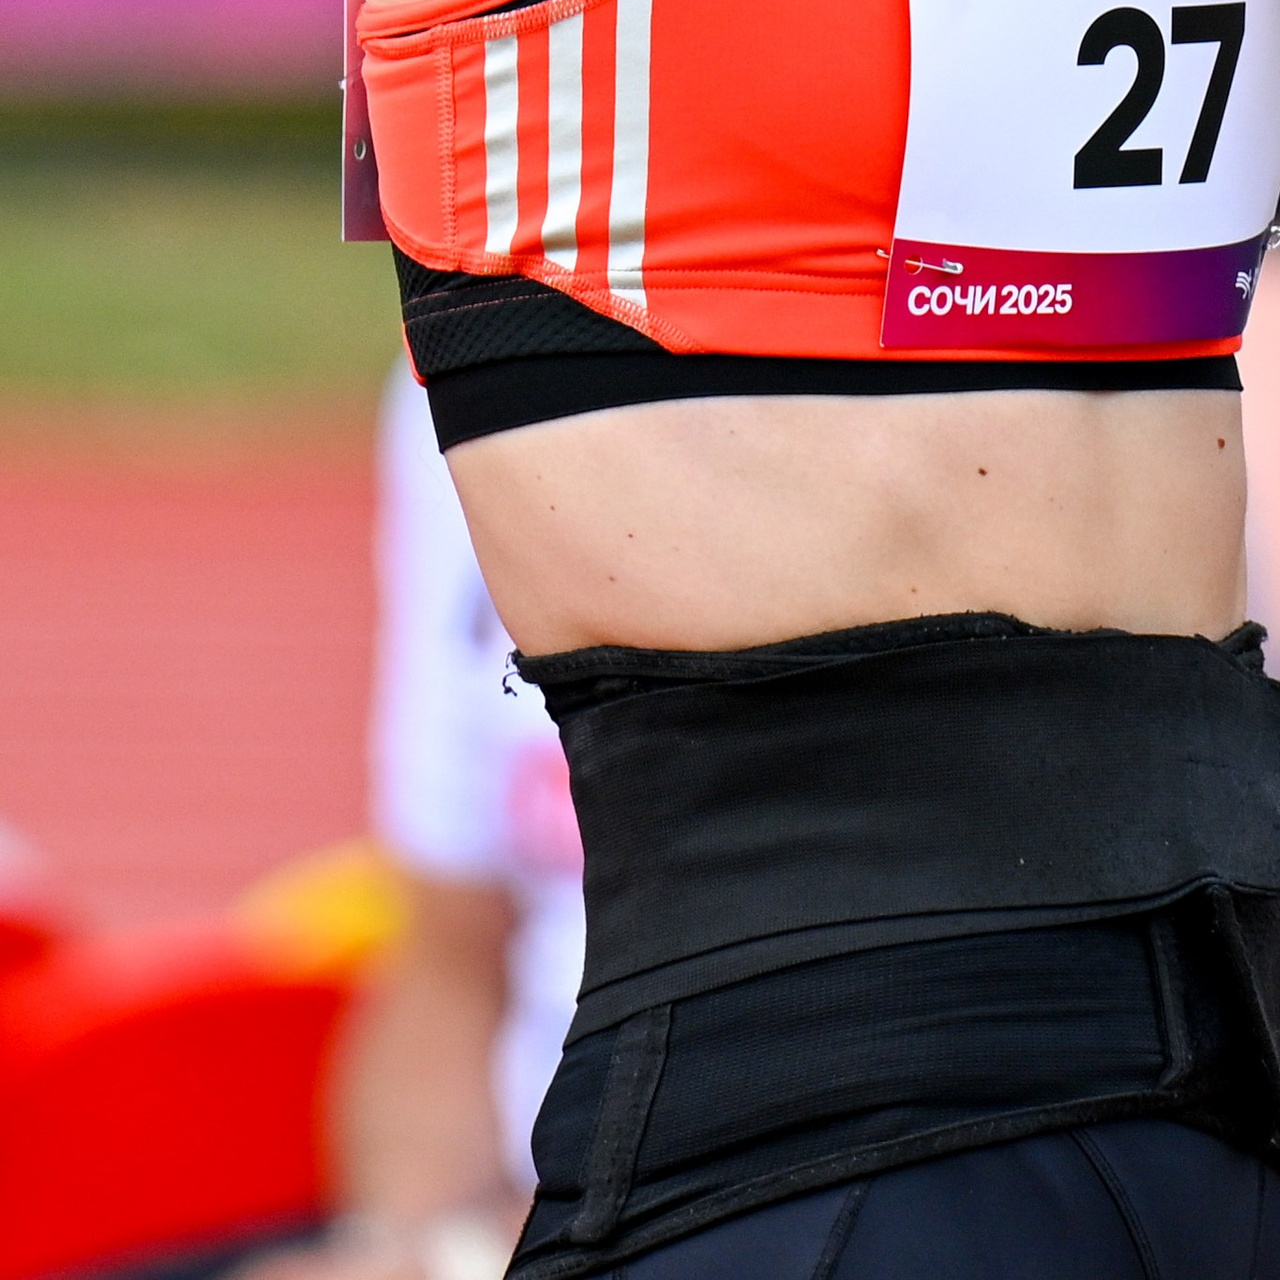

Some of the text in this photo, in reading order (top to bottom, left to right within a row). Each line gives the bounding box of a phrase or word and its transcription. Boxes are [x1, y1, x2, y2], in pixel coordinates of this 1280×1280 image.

[1073, 2, 1246, 189] 27
[907, 284, 1073, 316] СОЧИ 2025
